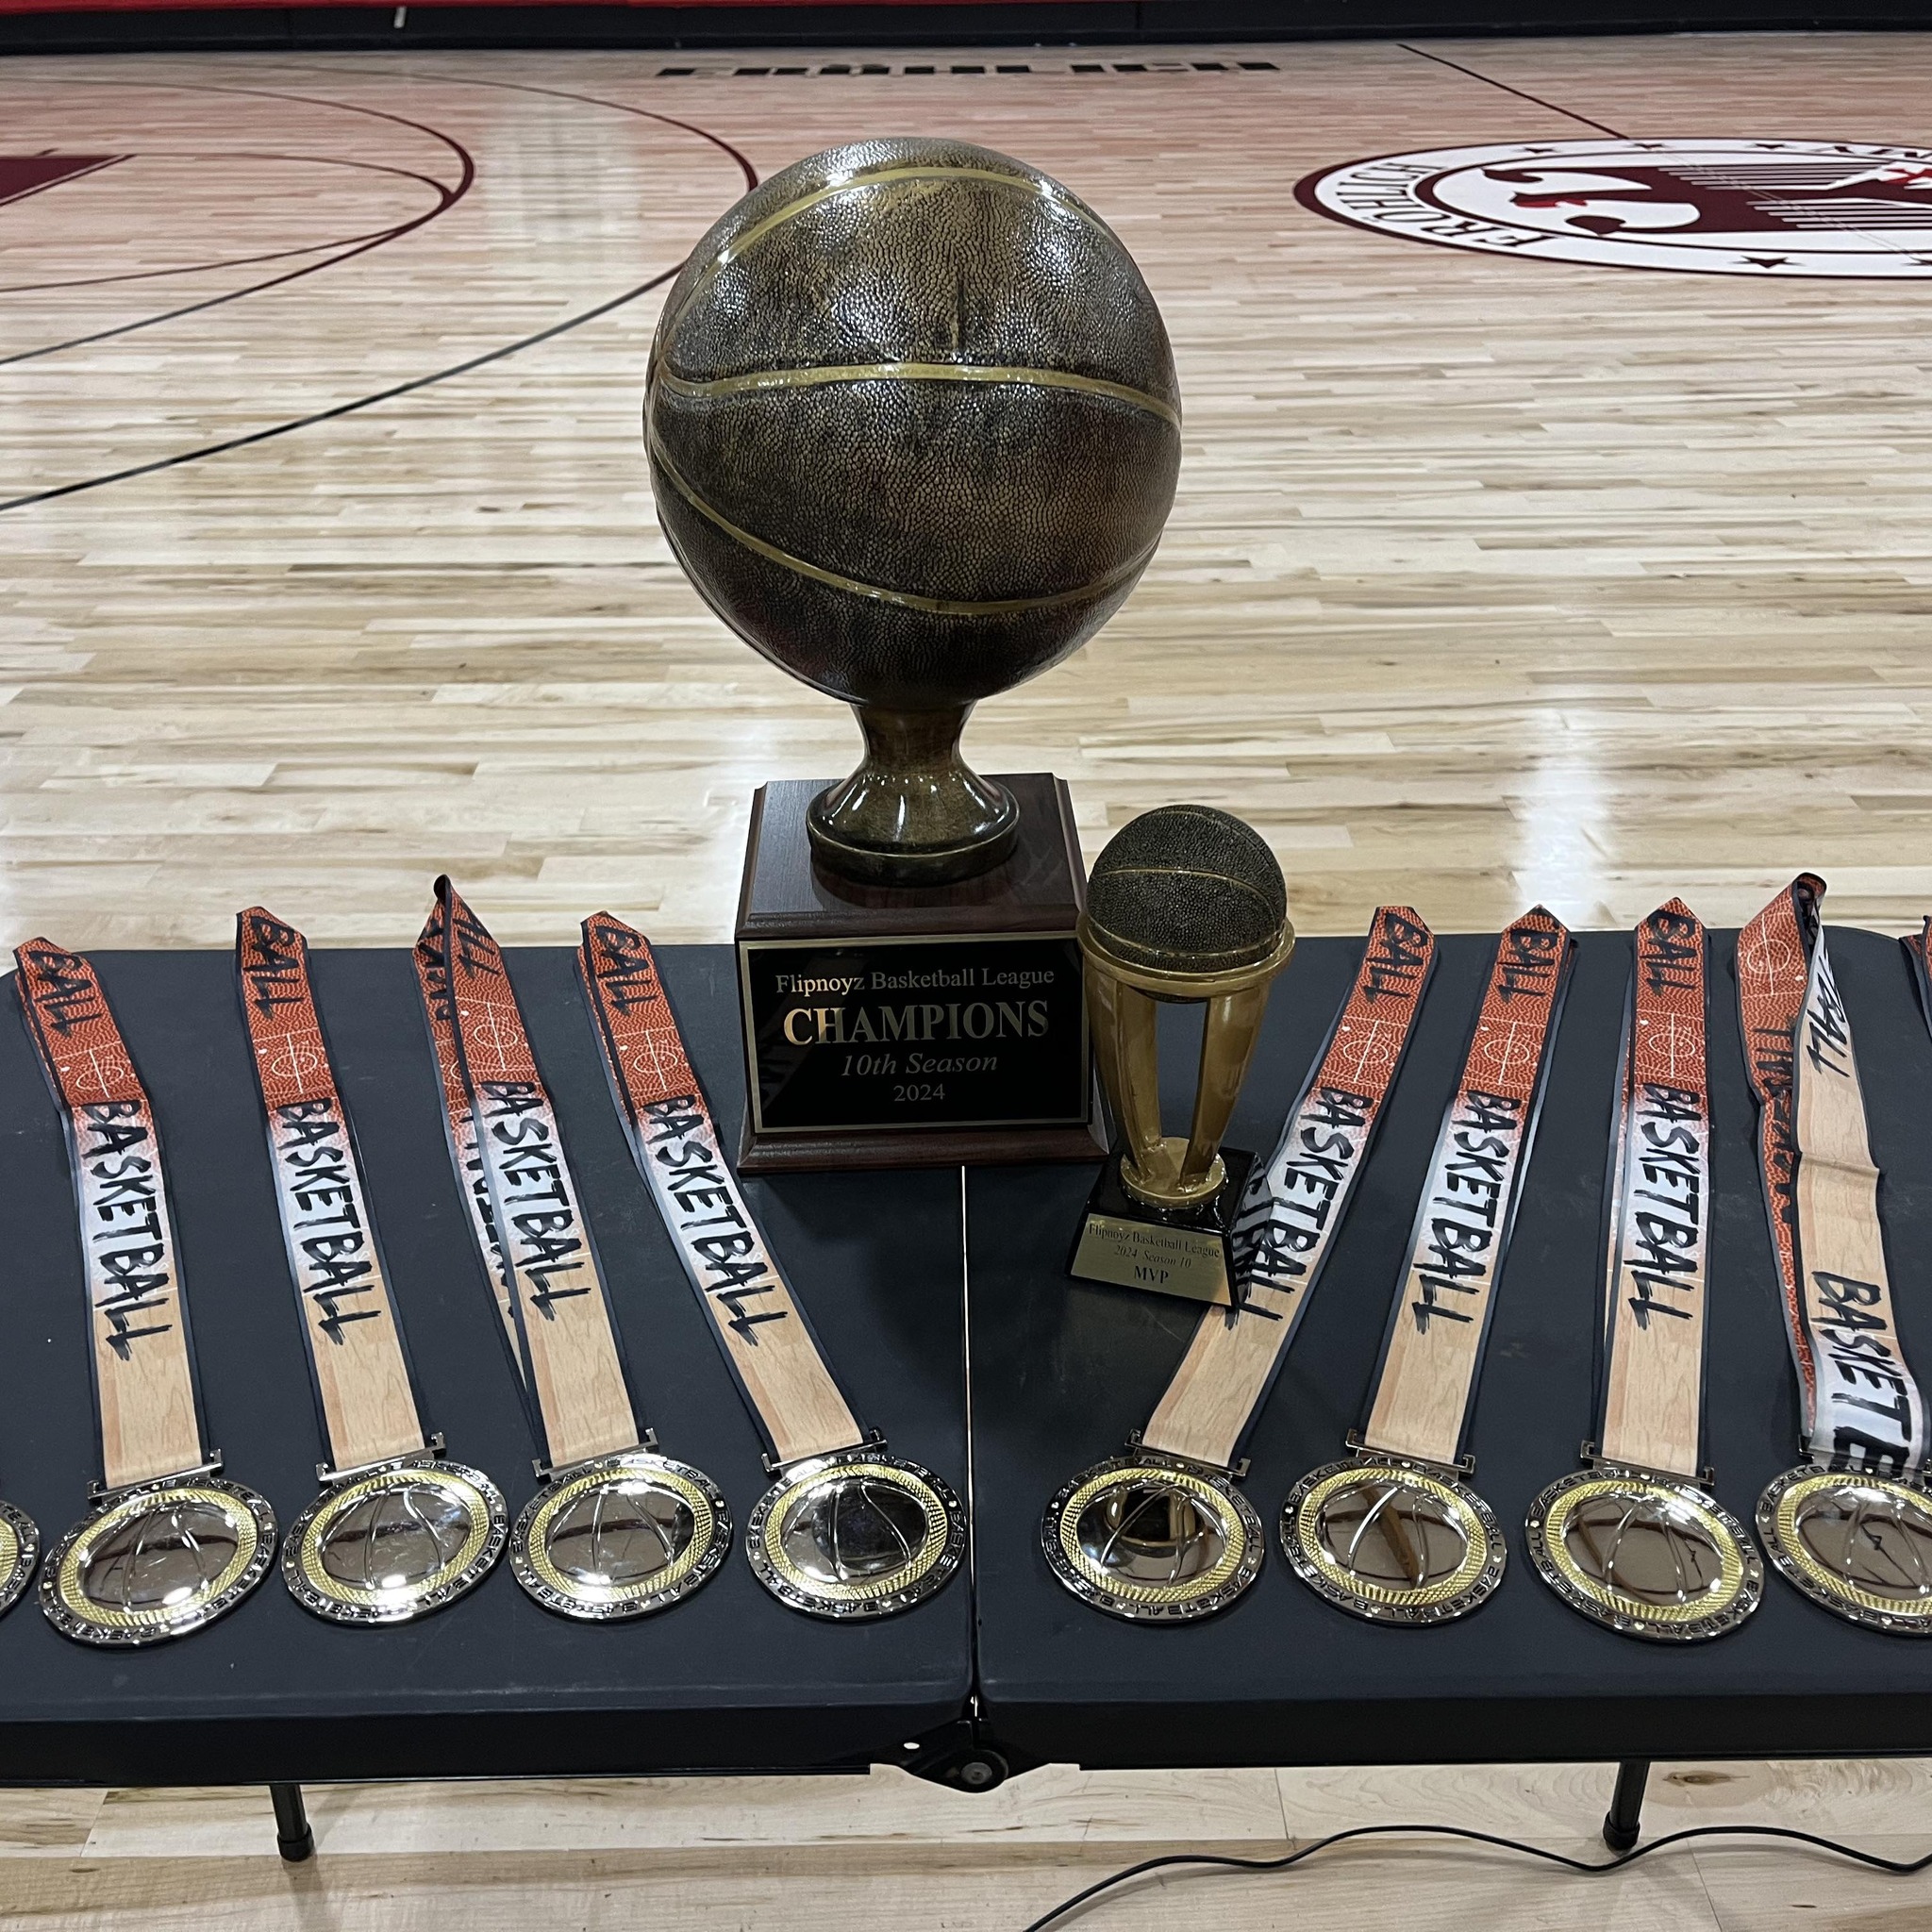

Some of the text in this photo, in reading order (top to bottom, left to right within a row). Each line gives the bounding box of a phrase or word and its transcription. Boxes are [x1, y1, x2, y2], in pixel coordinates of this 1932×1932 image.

[775, 967, 1056, 998] Flipnoyz Basketball League
[783, 999, 1050, 1046] CHAMPIONS
[841, 1052, 998, 1076] 10th Season
[892, 1083, 946, 1102] 2024
[80, 1099, 173, 1361] BASKETBALL
[275, 1096, 382, 1346] BASKETBALL
[479, 1079, 591, 1322] BASKETBALL
[641, 1093, 789, 1347] BASKETBALL
[1089, 1224, 1221, 1257] Flipnoyz Basketball League
[1114, 1244, 1192, 1269] 2024 Season 10
[1225, 1086, 1374, 1331] BASKETBALL
[1412, 1089, 1522, 1335] BASKETBALL
[1624, 1081, 1705, 1331] BASKETBALL
[1134, 1265, 1170, 1284] MVP
